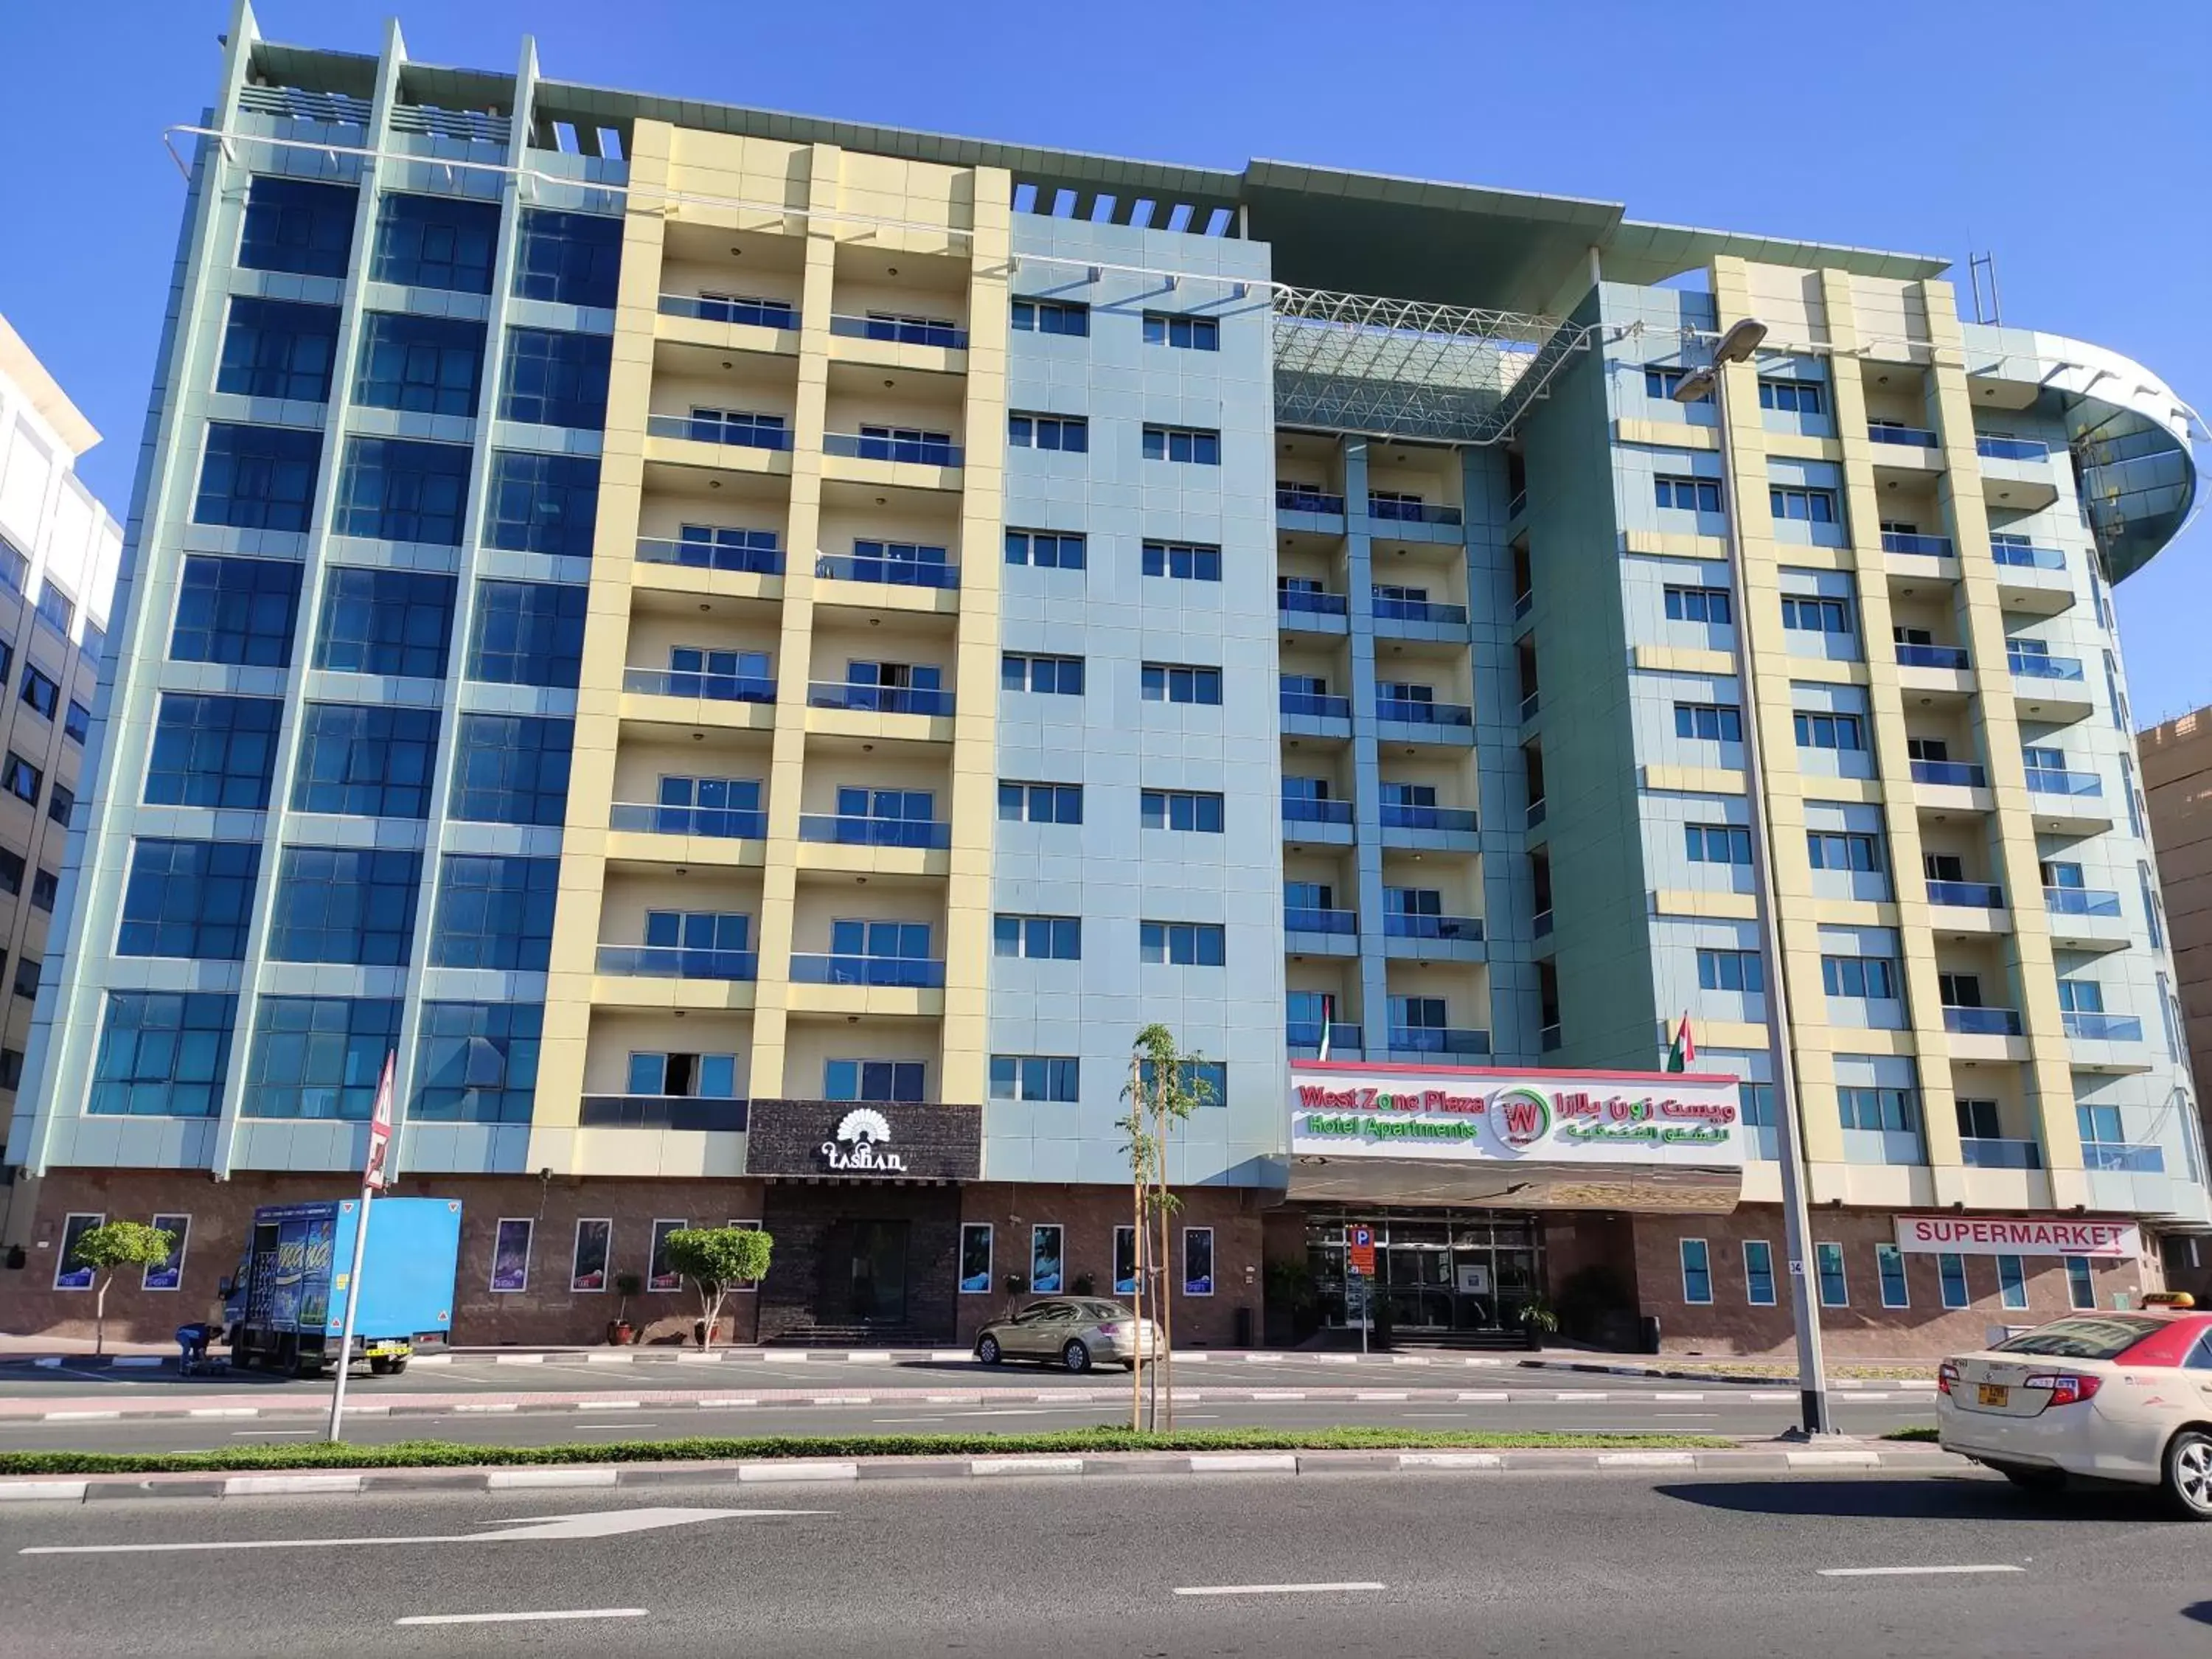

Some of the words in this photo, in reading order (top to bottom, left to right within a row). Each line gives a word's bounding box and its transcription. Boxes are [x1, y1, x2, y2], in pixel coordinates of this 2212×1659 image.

[1299, 1085, 1357, 1108] West
[1362, 1088, 1419, 1110] Zone
[1425, 1091, 1485, 1113] Plaza
[1555, 1093, 1601, 1119] بلازا
[1610, 1096, 1654, 1121] زون
[1662, 1099, 1736, 1124] ويست
[1307, 1114, 1359, 1135] Hotel
[1366, 1116, 1478, 1140] Apartments
[1509, 1103, 1537, 1133] W
[1358, 1230, 1368, 1245] P
[1916, 1222, 2123, 1246] SUPERMARKET
